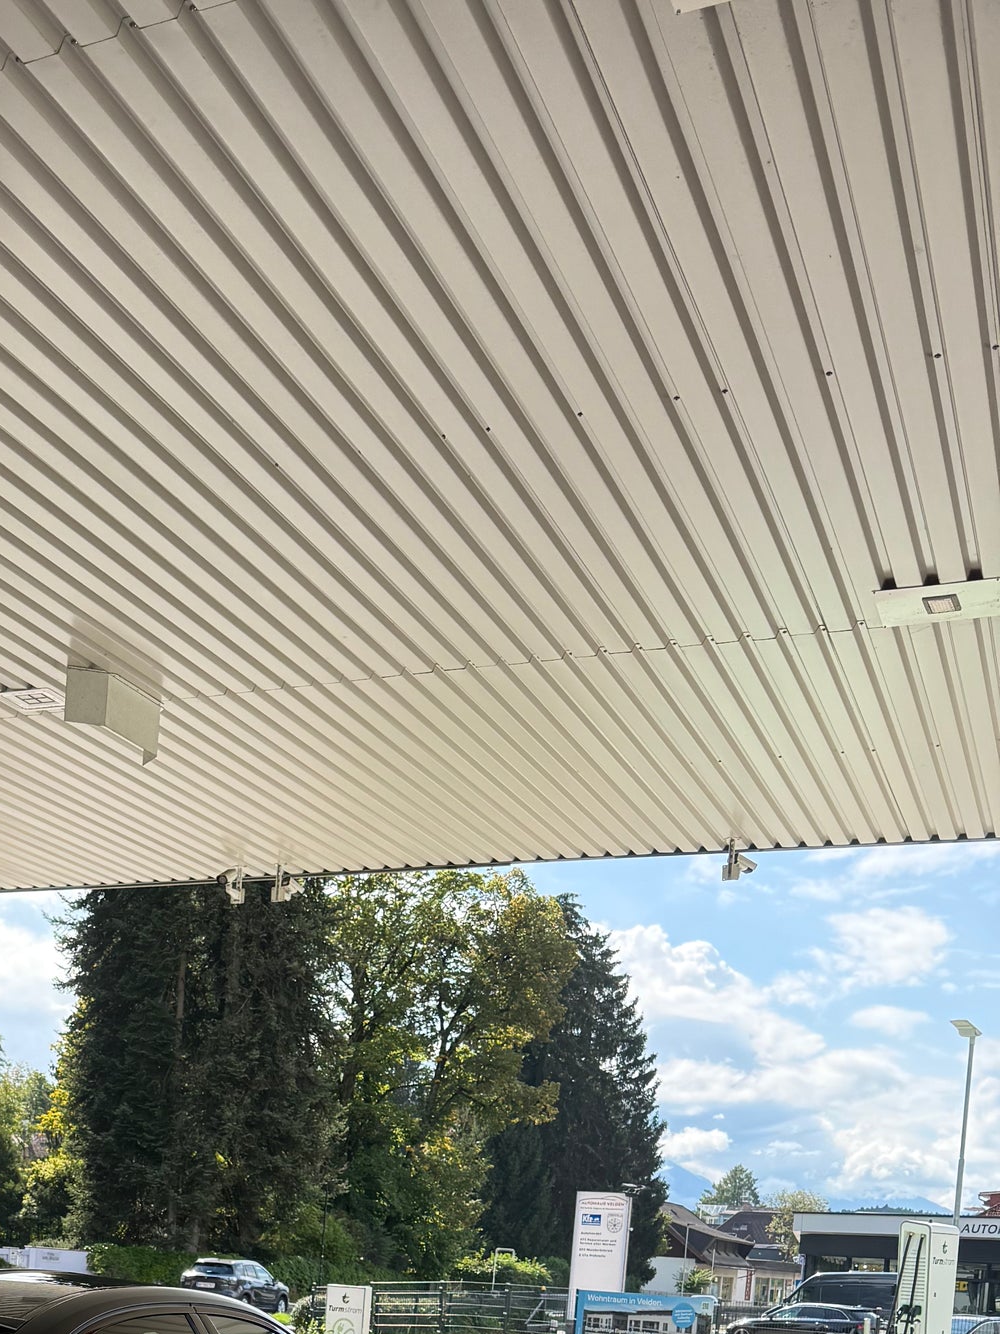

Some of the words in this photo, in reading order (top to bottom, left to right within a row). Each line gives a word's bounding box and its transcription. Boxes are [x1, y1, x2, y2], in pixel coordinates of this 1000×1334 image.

[961, 1223, 1000, 1234] AUTO
[587, 1294, 628, 1304] Wohntraum
[629, 1296, 636, 1304] in
[328, 1304, 363, 1315] Turmstrom
